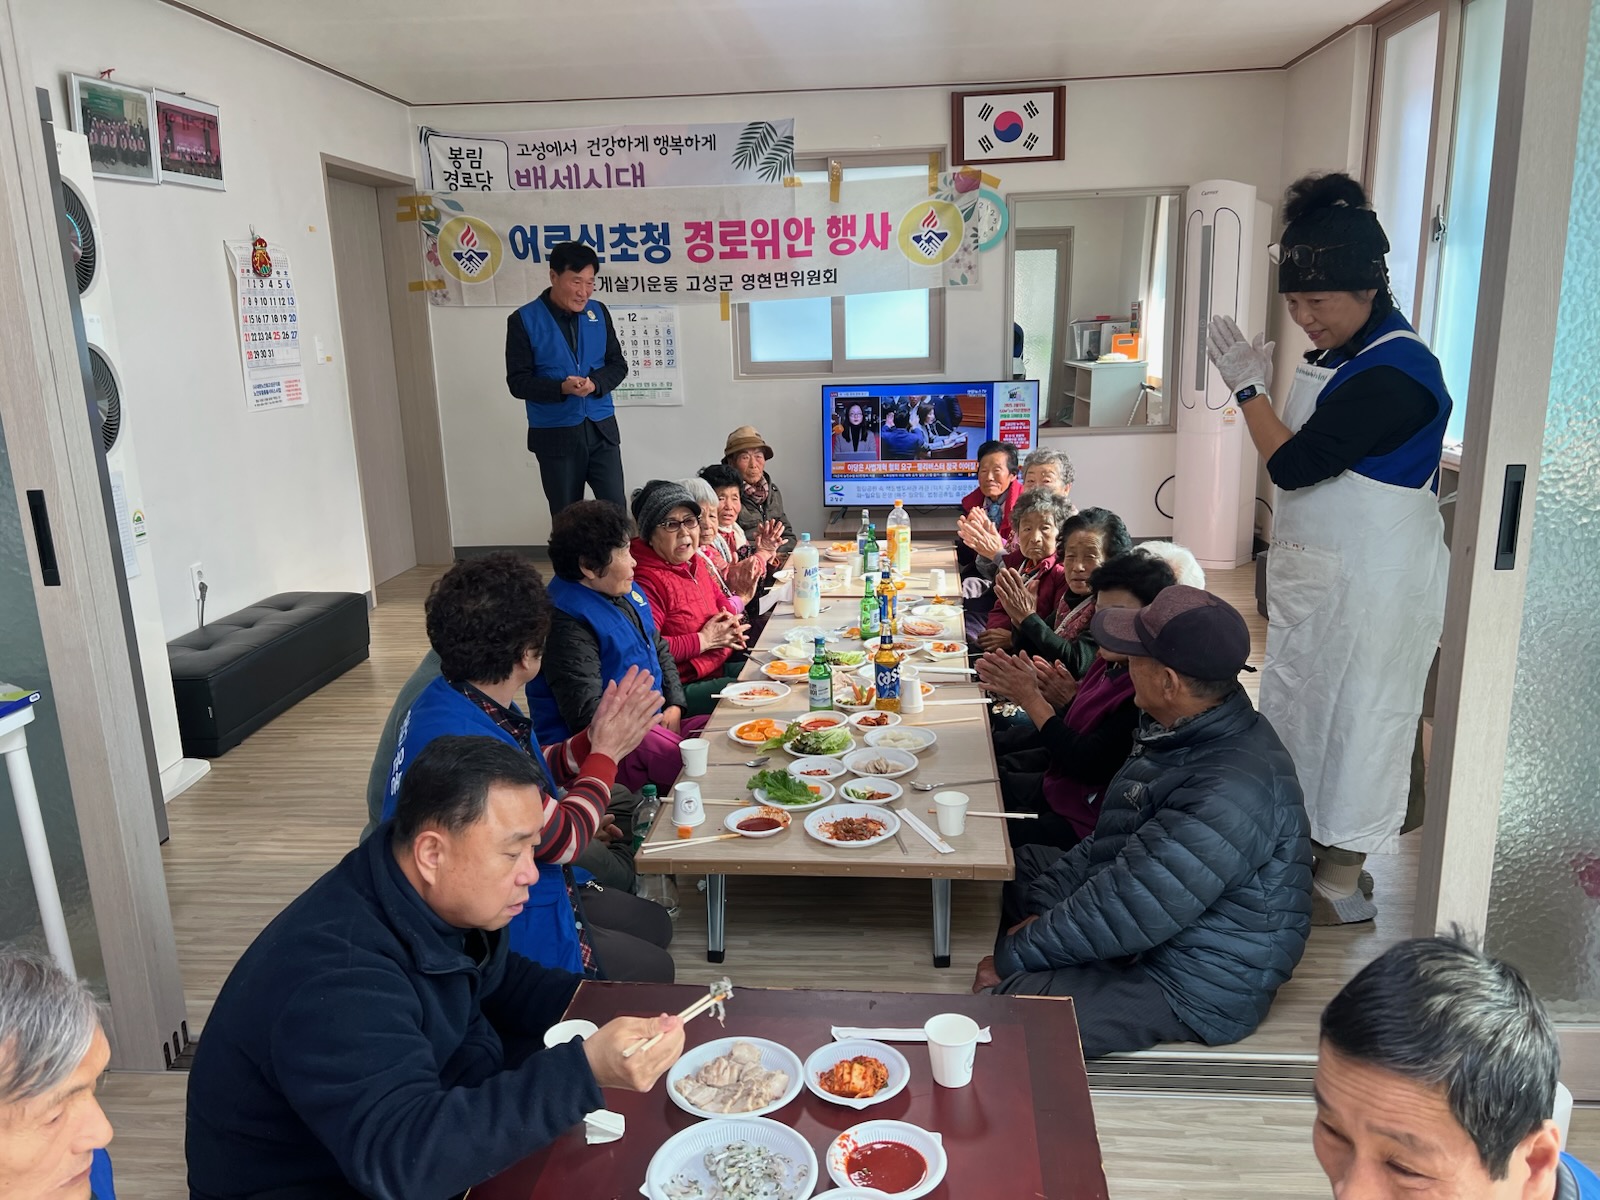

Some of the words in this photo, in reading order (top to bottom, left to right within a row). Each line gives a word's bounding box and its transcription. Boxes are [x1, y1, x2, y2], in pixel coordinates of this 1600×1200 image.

[516, 139, 577, 160] 고성에서
[587, 135, 649, 157] 건강하게
[653, 133, 717, 155] 행복하게
[448, 147, 483, 169] 봉림
[443, 170, 493, 191] 경로당
[684, 217, 815, 263] 경로위안
[826, 211, 892, 256] 행사
[247, 279, 250, 288] 1
[253, 279, 257, 288] 2
[260, 280, 264, 288] 3
[268, 280, 273, 288] 4
[278, 280, 282, 288] 5
[286, 280, 290, 288] 6
[686, 274, 734, 292] 고성군
[741, 268, 838, 291] 영현면위원회
[242, 297, 246, 306] 7
[248, 297, 252, 306] 8
[254, 297, 258, 306] 9
[260, 297, 267, 306] 10
[270, 297, 276, 306] 11
[278, 297, 285, 306] 12
[242, 315, 248, 323] 14
[249, 315, 254, 323] 15
[256, 315, 261, 323] 16
[263, 314, 269, 323] 17
[271, 314, 278, 323] 18
[280, 314, 287, 323] 19
[289, 314, 296, 322] 20
[628, 313, 637, 322] 12
[244, 333, 250, 342] 21
[251, 332, 257, 341] 22
[258, 332, 264, 341] 23
[265, 332, 272, 340] 24
[273, 332, 281, 340] 25
[282, 331, 289, 339] 26
[291, 331, 297, 339] 27
[247, 350, 253, 359] 28
[254, 350, 260, 359] 29
[260, 350, 267, 358] 30
[268, 350, 274, 358] 31
